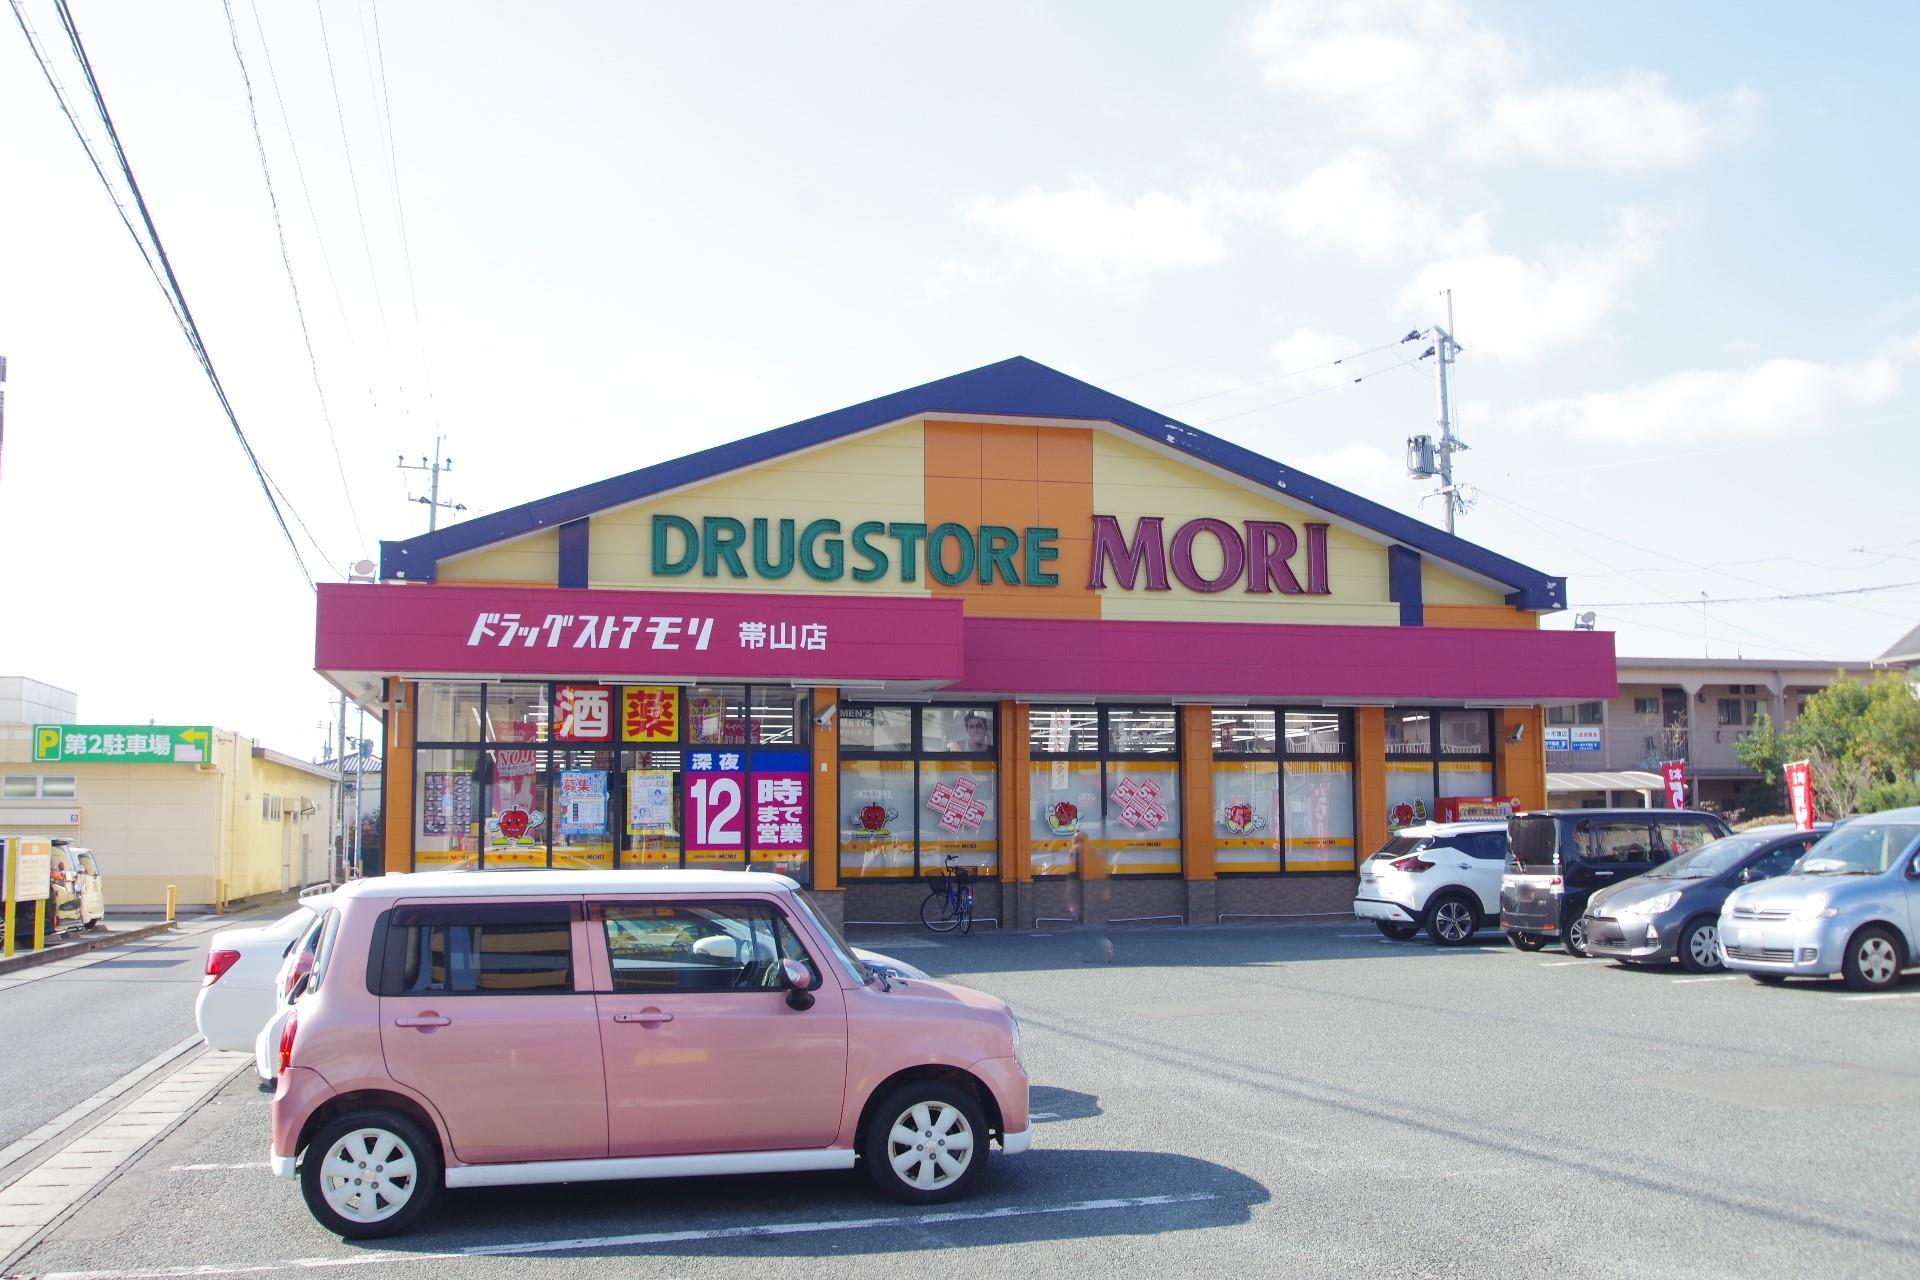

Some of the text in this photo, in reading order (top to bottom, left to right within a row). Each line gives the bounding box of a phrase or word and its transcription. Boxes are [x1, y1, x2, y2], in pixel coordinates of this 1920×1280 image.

[650, 513, 1332, 595] DRUGSTORE MORI
[467, 612, 827, 651] ドラッグストアモリ 帯山店
[560, 688, 608, 738] 酒
[626, 688, 675, 738] 薬
[840, 709, 872, 718] MEN'S
[38, 729, 171, 758] P 第2駐車場
[692, 753, 739, 770] 深夜
[562, 778, 592, 792] 募集
[758, 779, 803, 804] 時
[691, 778, 741, 845] 12
[757, 806, 803, 823] まで
[757, 823, 803, 844] 営業
